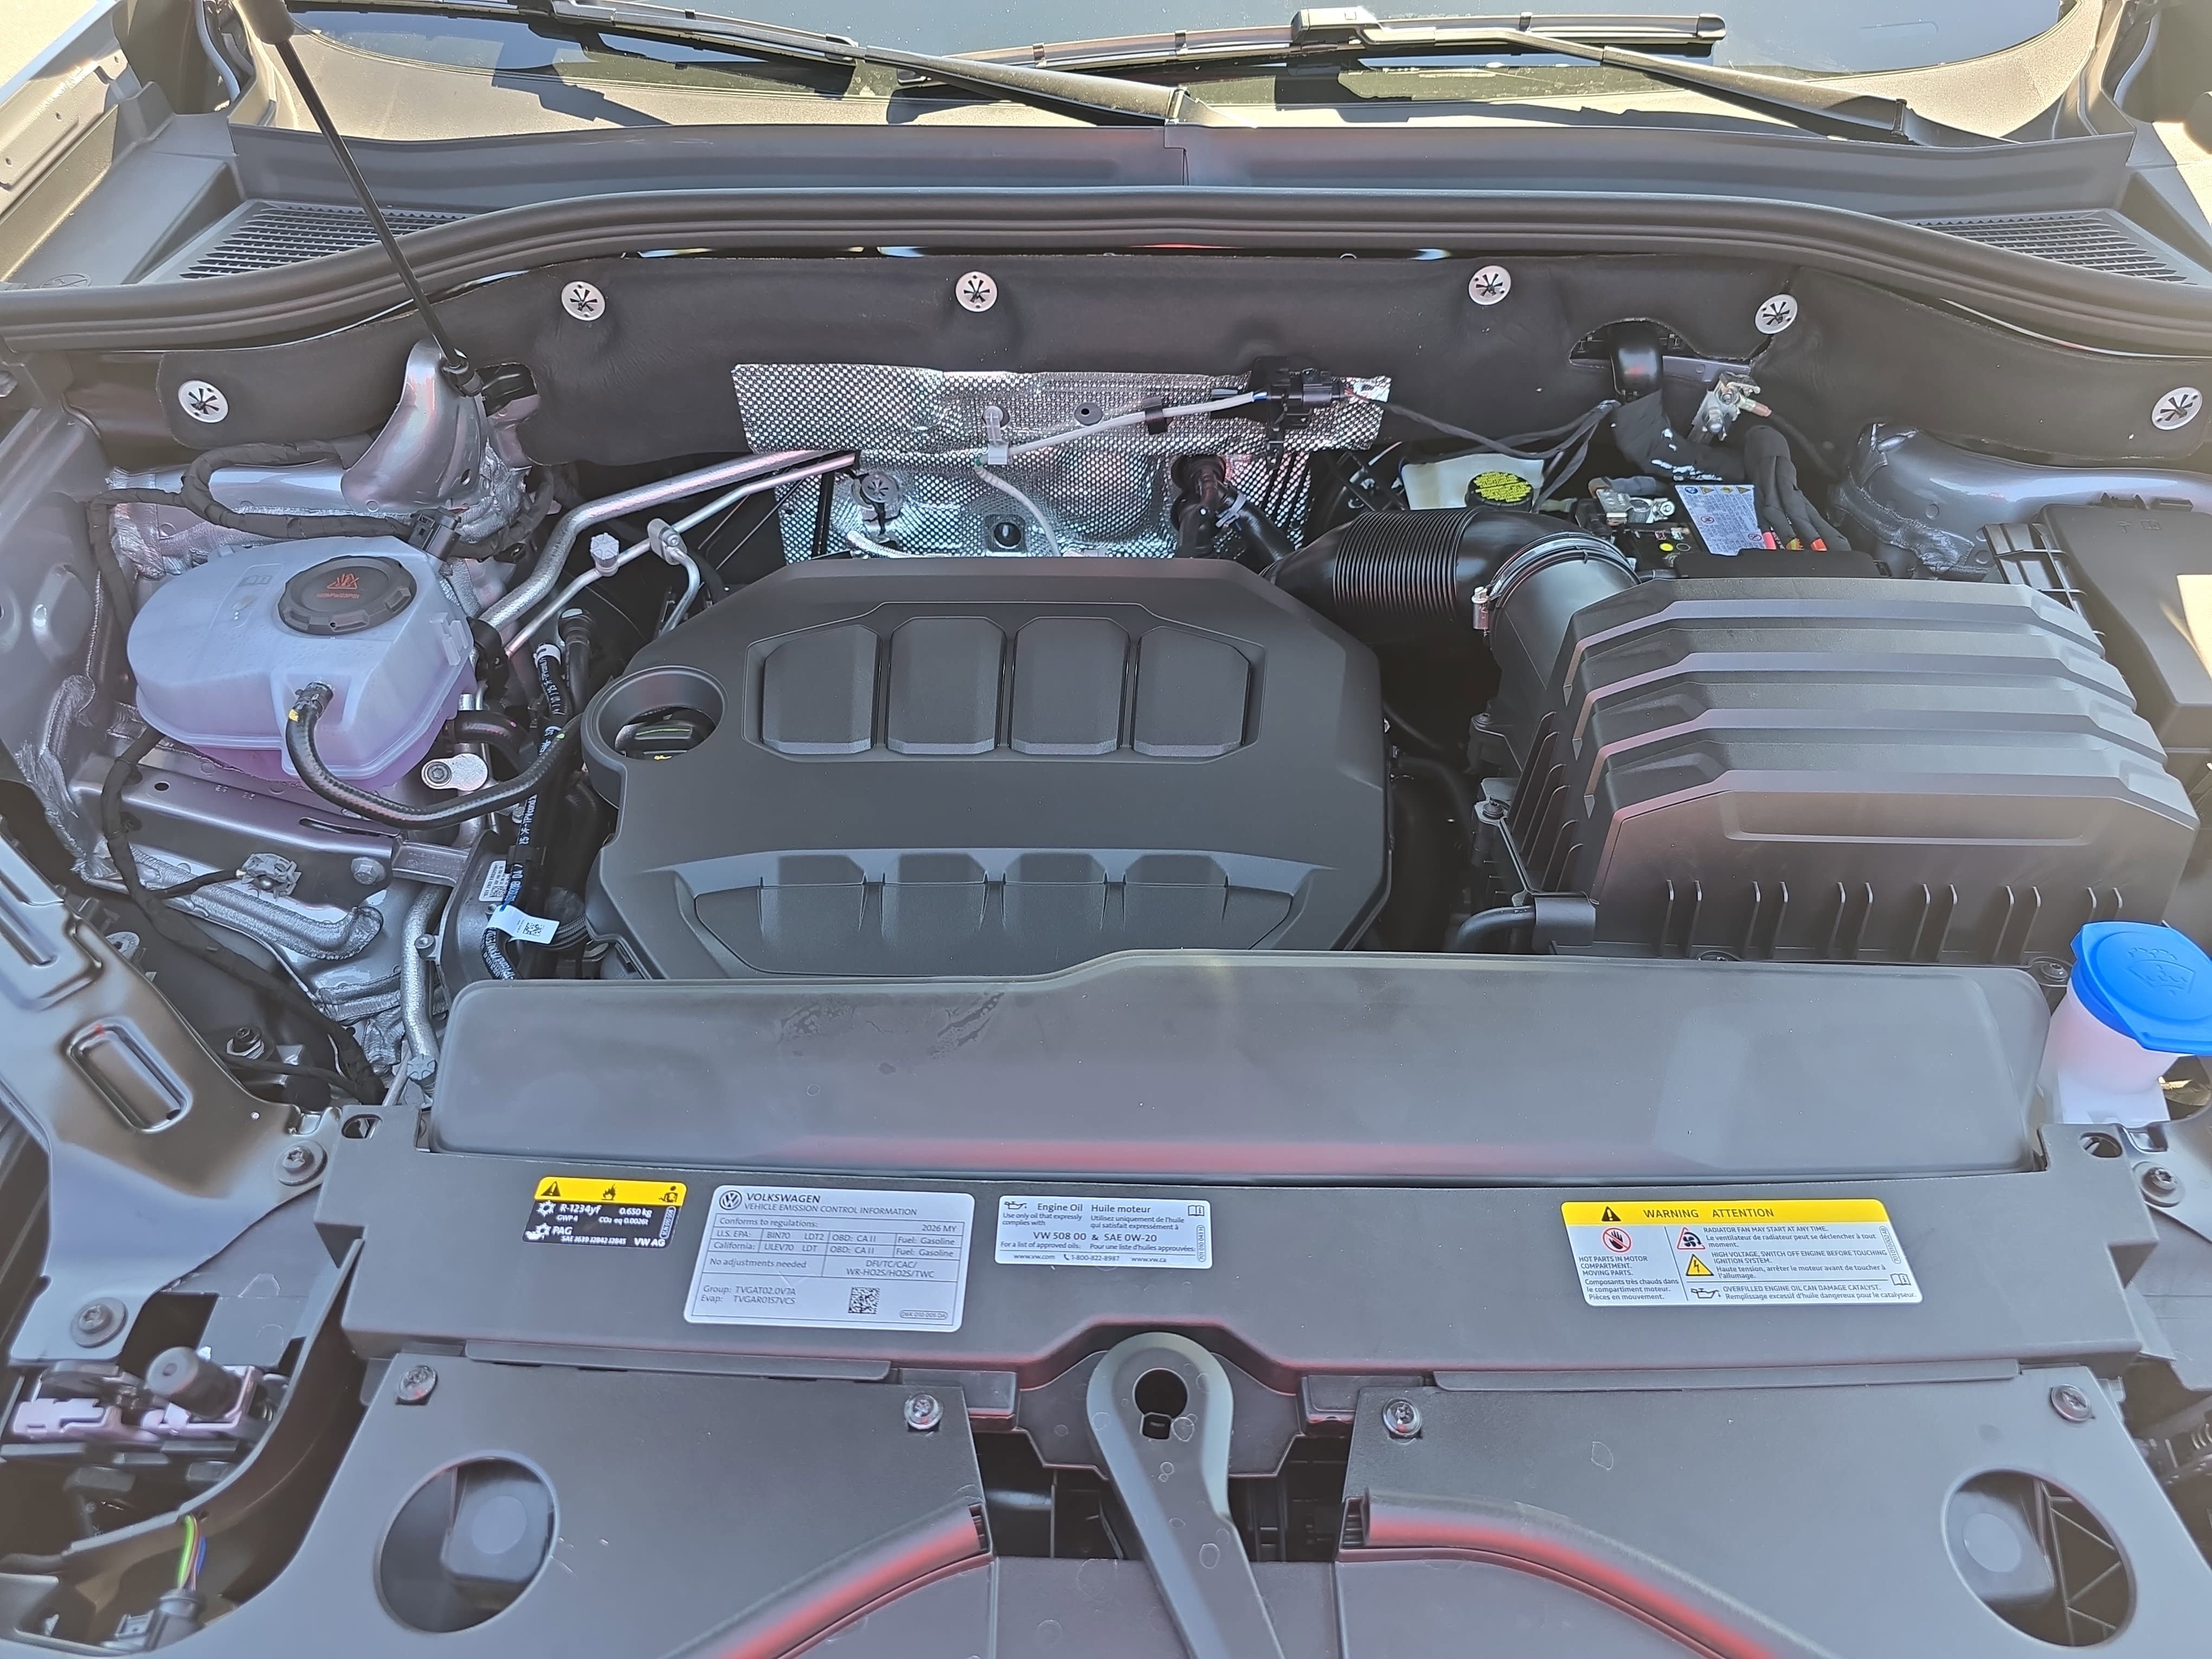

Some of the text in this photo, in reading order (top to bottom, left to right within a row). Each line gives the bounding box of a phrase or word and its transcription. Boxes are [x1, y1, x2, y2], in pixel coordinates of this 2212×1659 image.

[747, 1193, 820, 1203] VOLKSWAGEN
[560, 1204, 602, 1216] R-1234yf
[820, 1205, 857, 1213] CONTROL
[1037, 1203, 1068, 1211] Engine
[642, 1208, 652, 1218] kg
[1643, 1208, 1774, 1218] WARNING ATTENTION
[770, 1219, 818, 1227] regulations:
[552, 1226, 573, 1235] PAG
[634, 1238, 651, 1246] VW
[713, 1241, 755, 1250] California:
[920, 1237, 954, 1245] Gasoline
[918, 1249, 953, 1257] Gasoline
[723, 1258, 774, 1267] adjustments
[703, 1285, 731, 1294] Group:
[700, 1294, 723, 1303] Evap:
